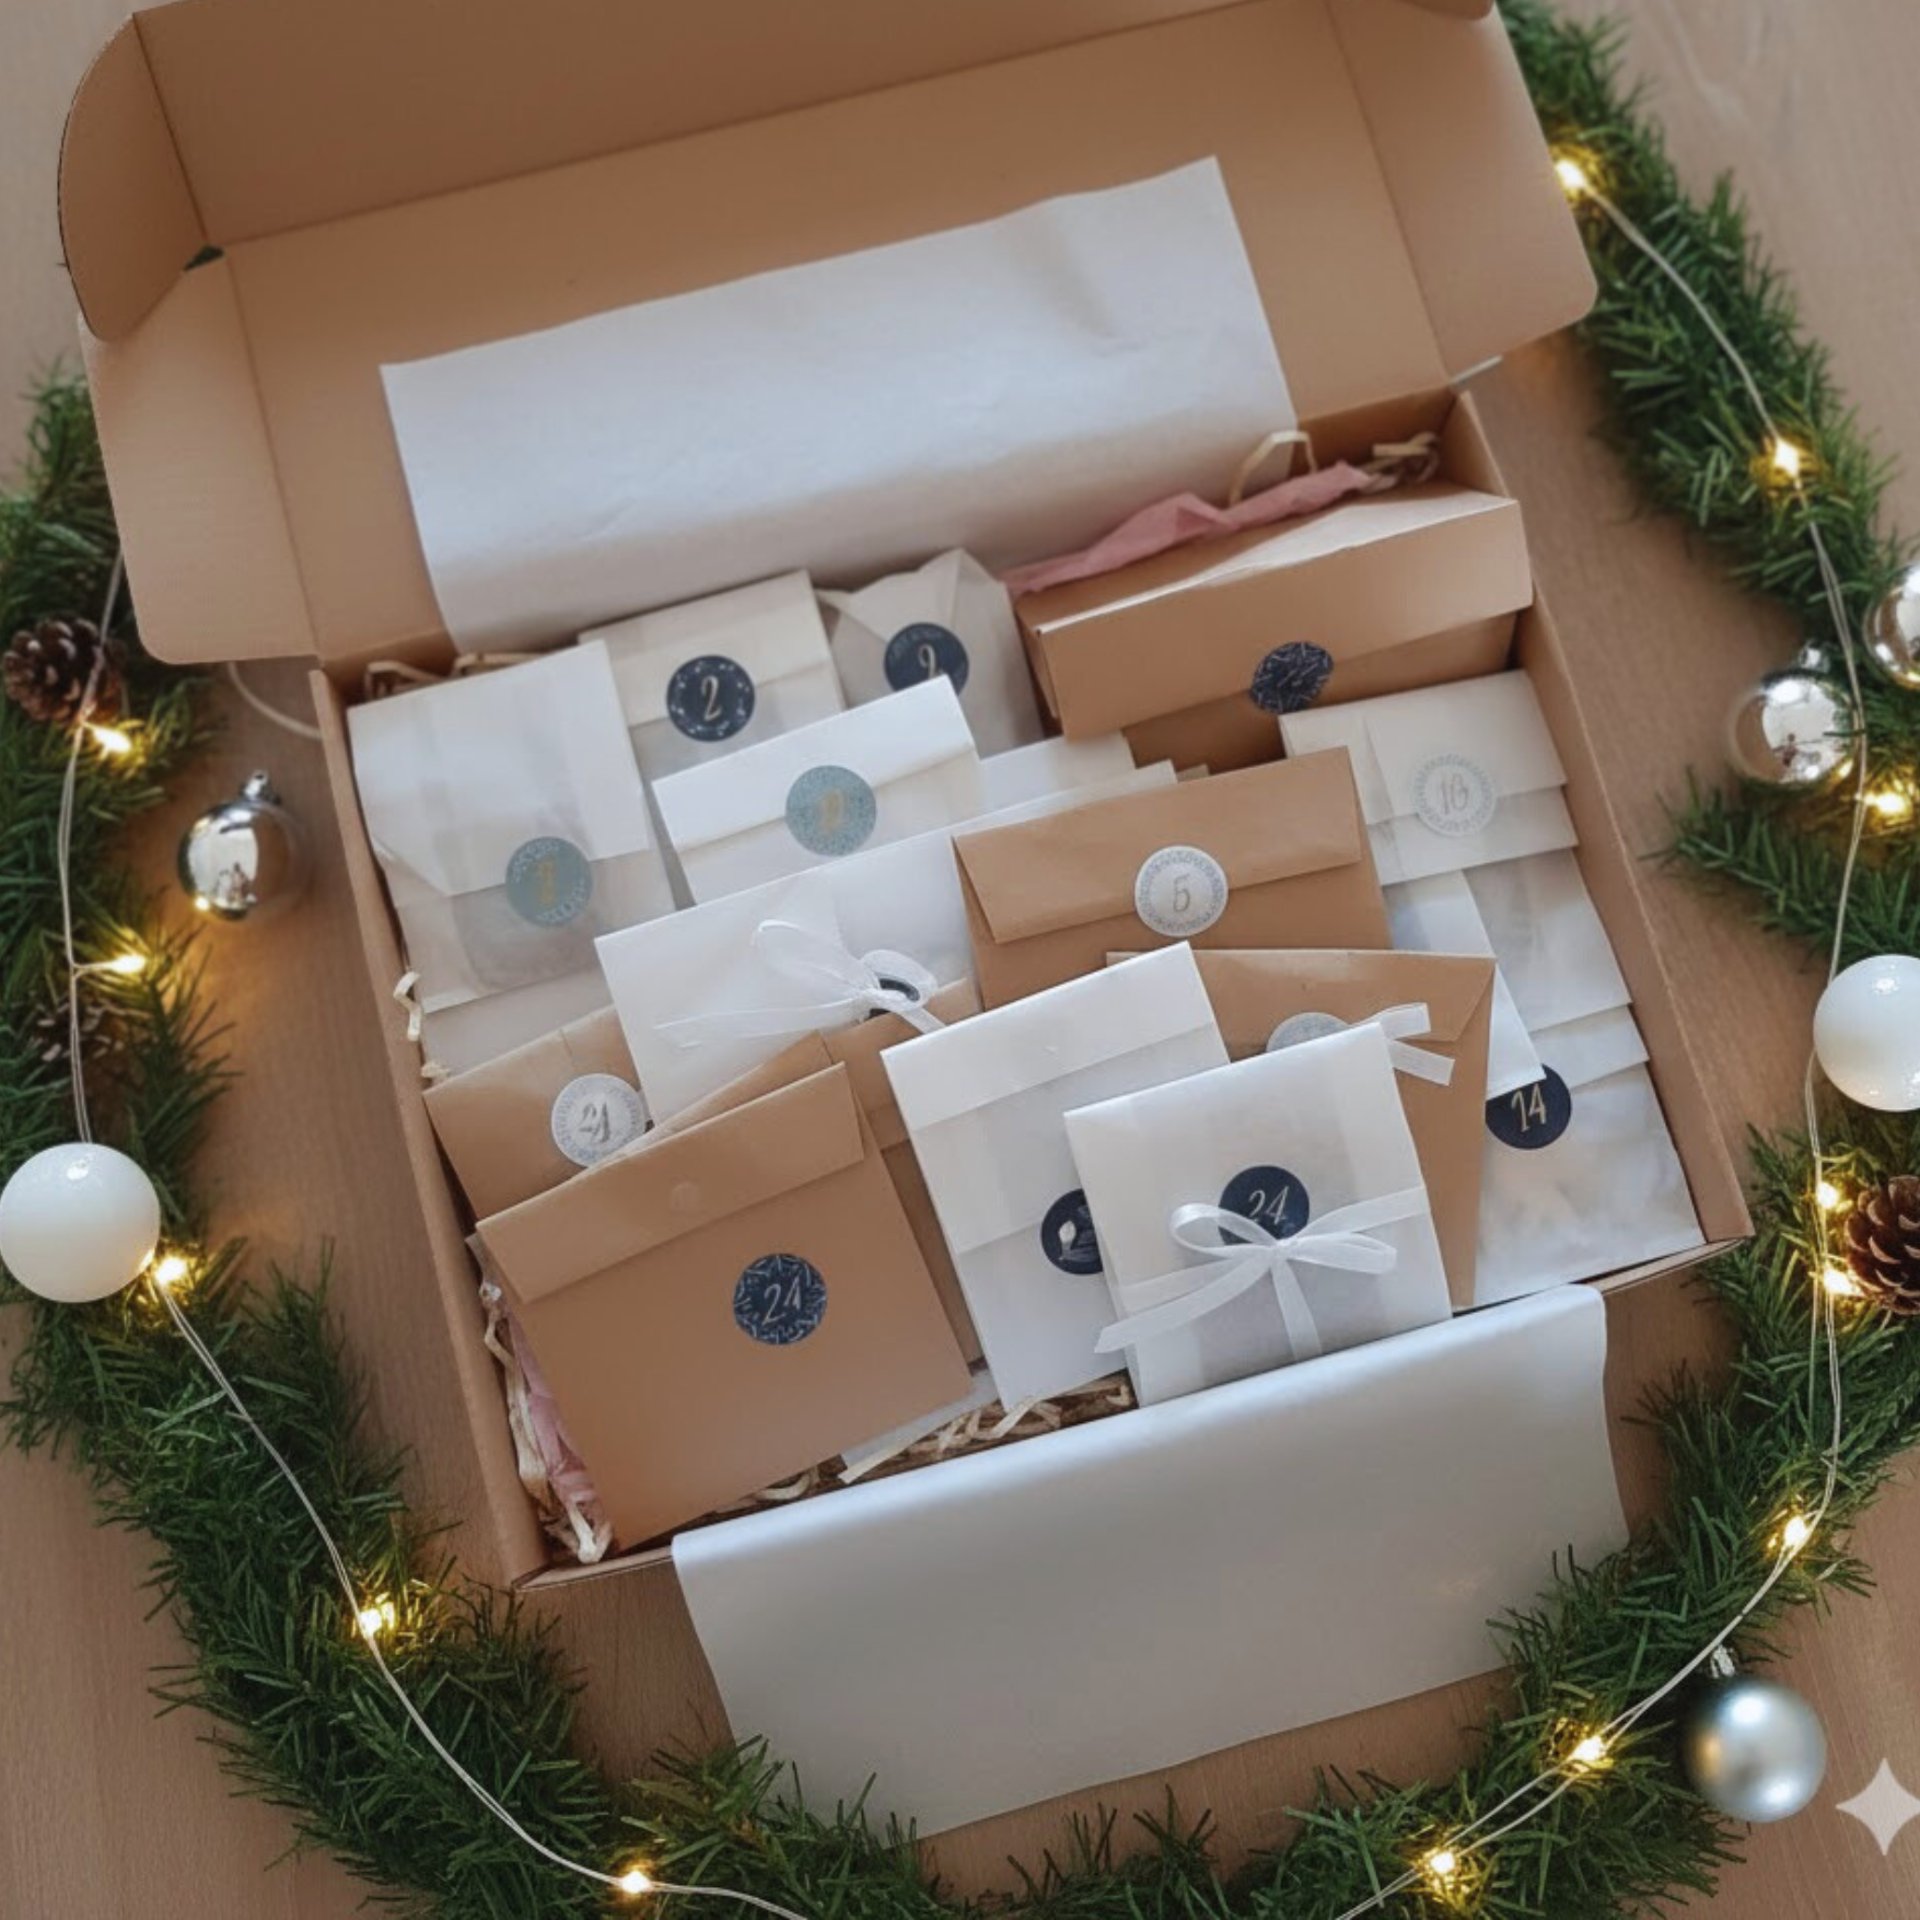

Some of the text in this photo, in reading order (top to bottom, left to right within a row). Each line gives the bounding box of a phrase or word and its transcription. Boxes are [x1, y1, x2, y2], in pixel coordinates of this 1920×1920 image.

[700, 674, 721, 722] 2
[1511, 1082, 1548, 1132] 14
[1248, 1185, 1290, 1226] 24
